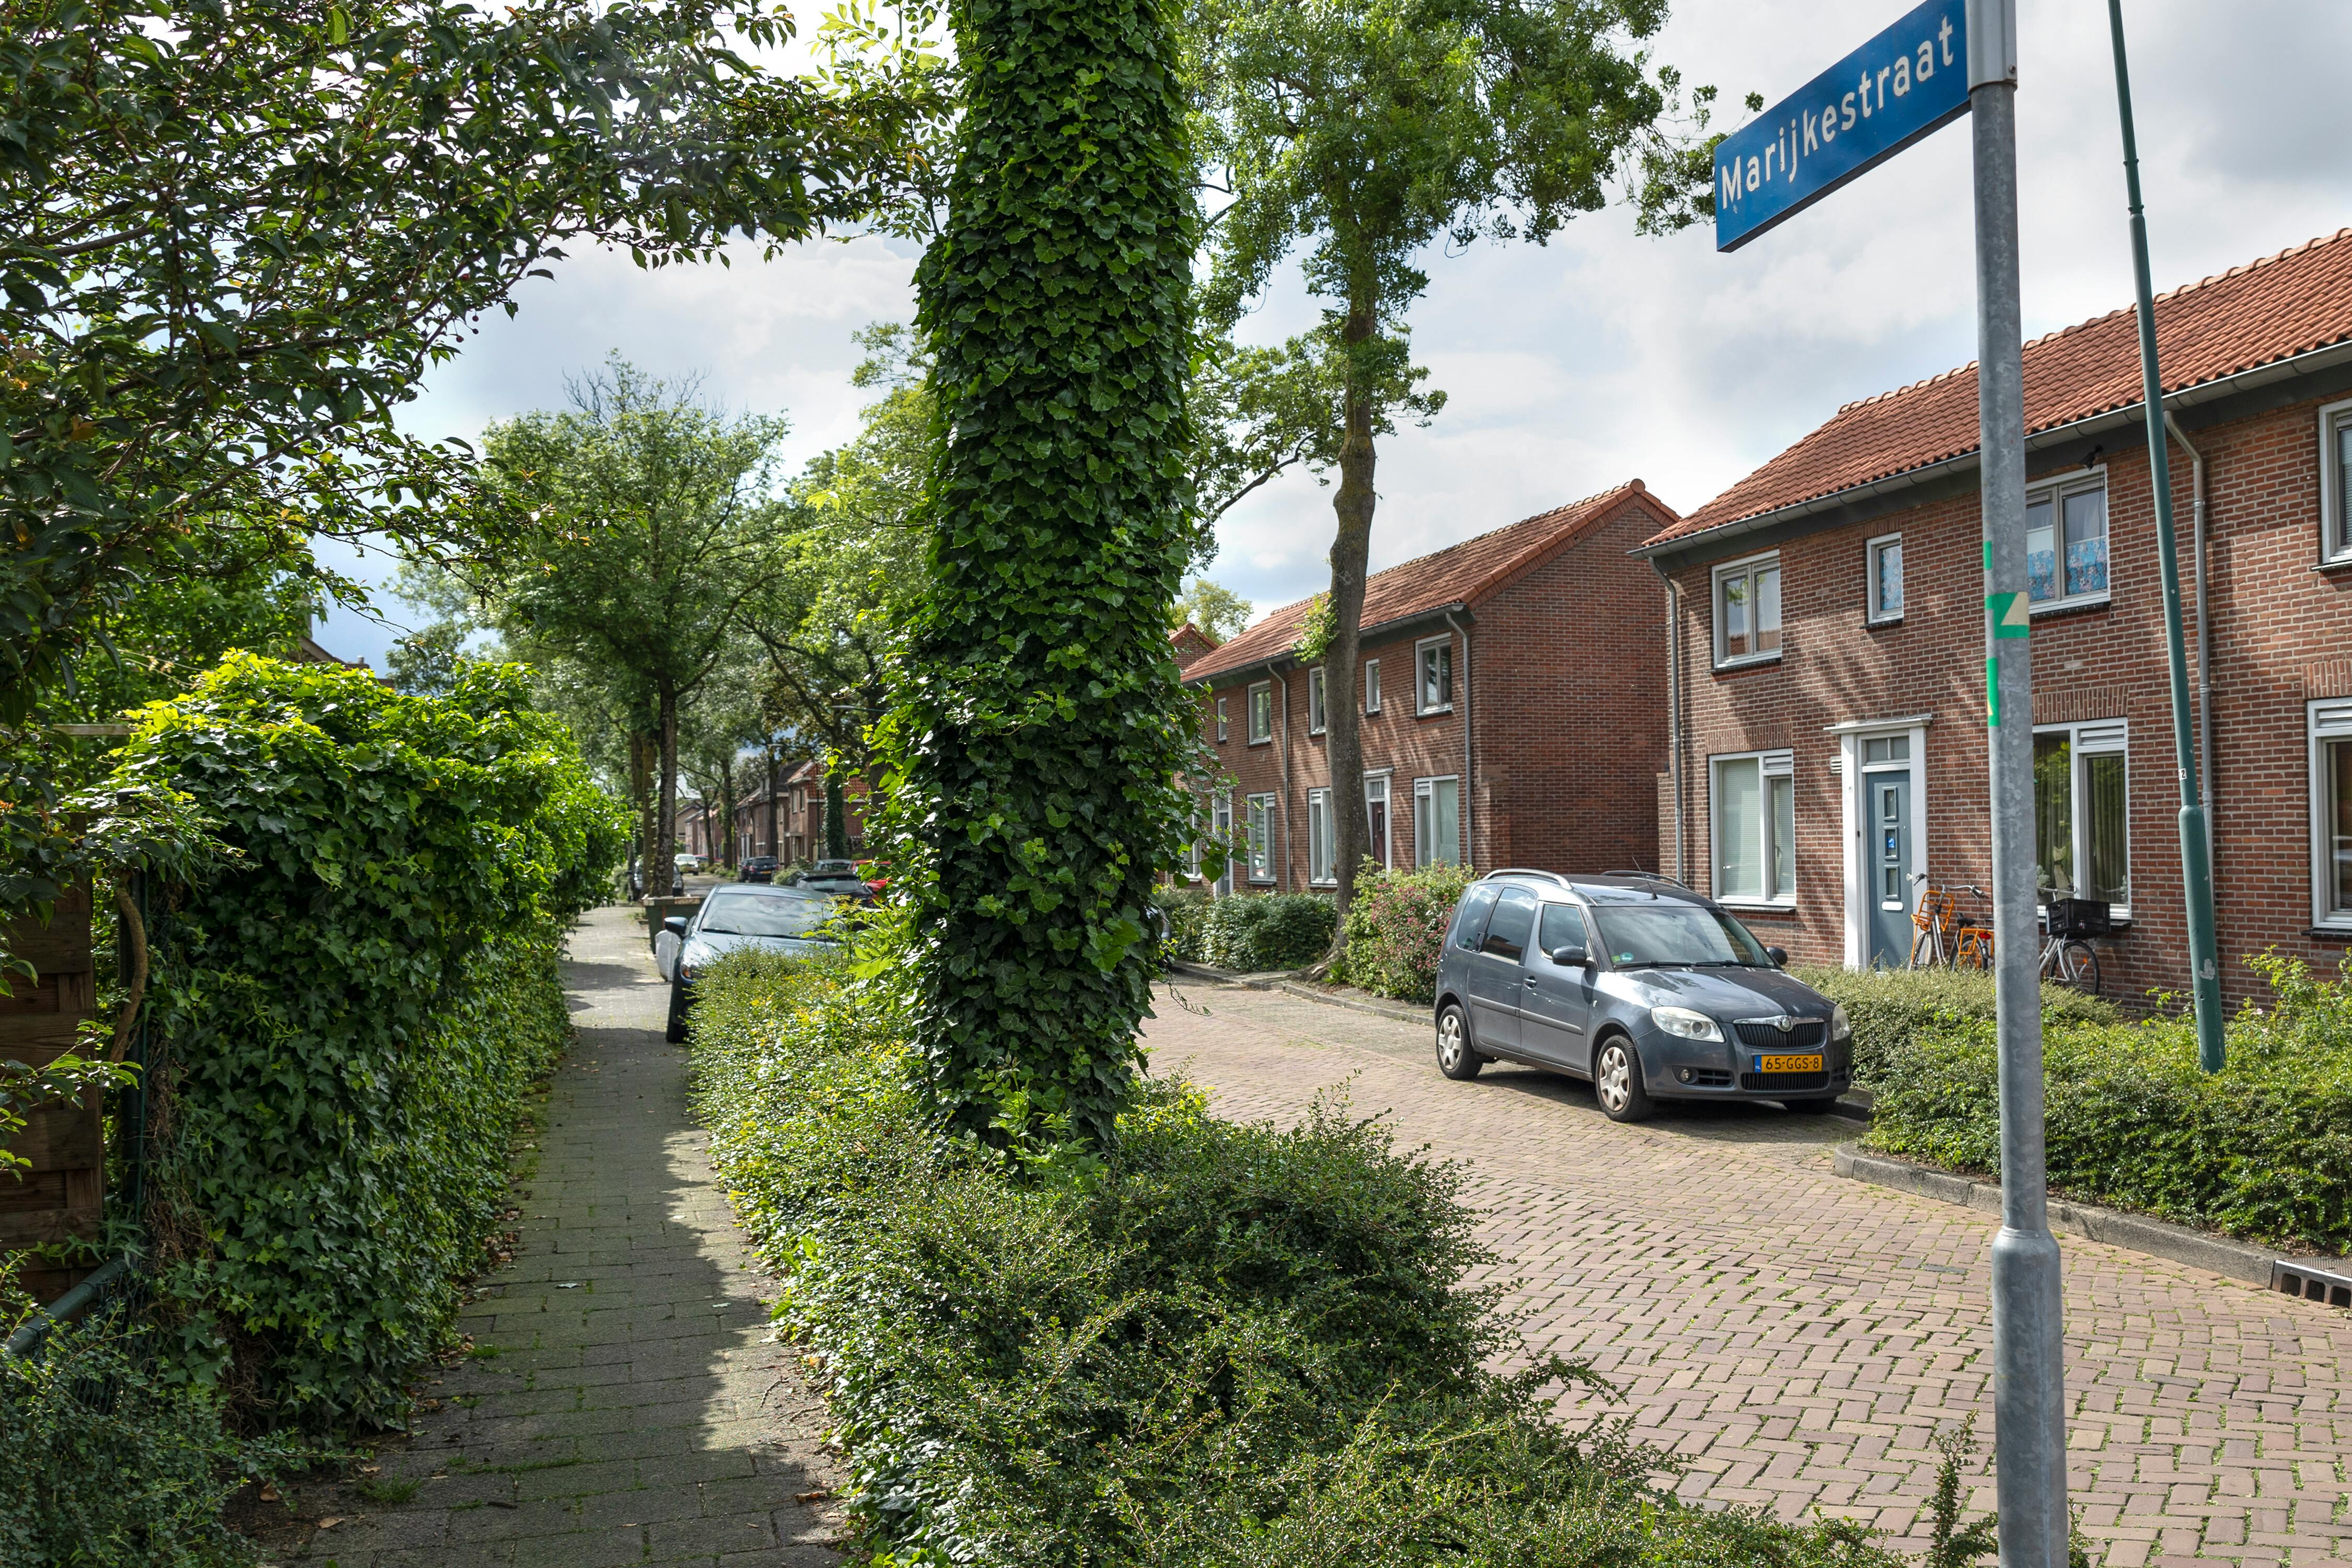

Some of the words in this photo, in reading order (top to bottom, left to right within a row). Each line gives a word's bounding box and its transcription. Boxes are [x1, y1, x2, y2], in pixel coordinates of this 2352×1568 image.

[1722, 16, 1953, 209] Marijkestraat
[2178, 769, 2186, 778] 2
[1766, 1057, 1819, 1069] 65-GGS-8
